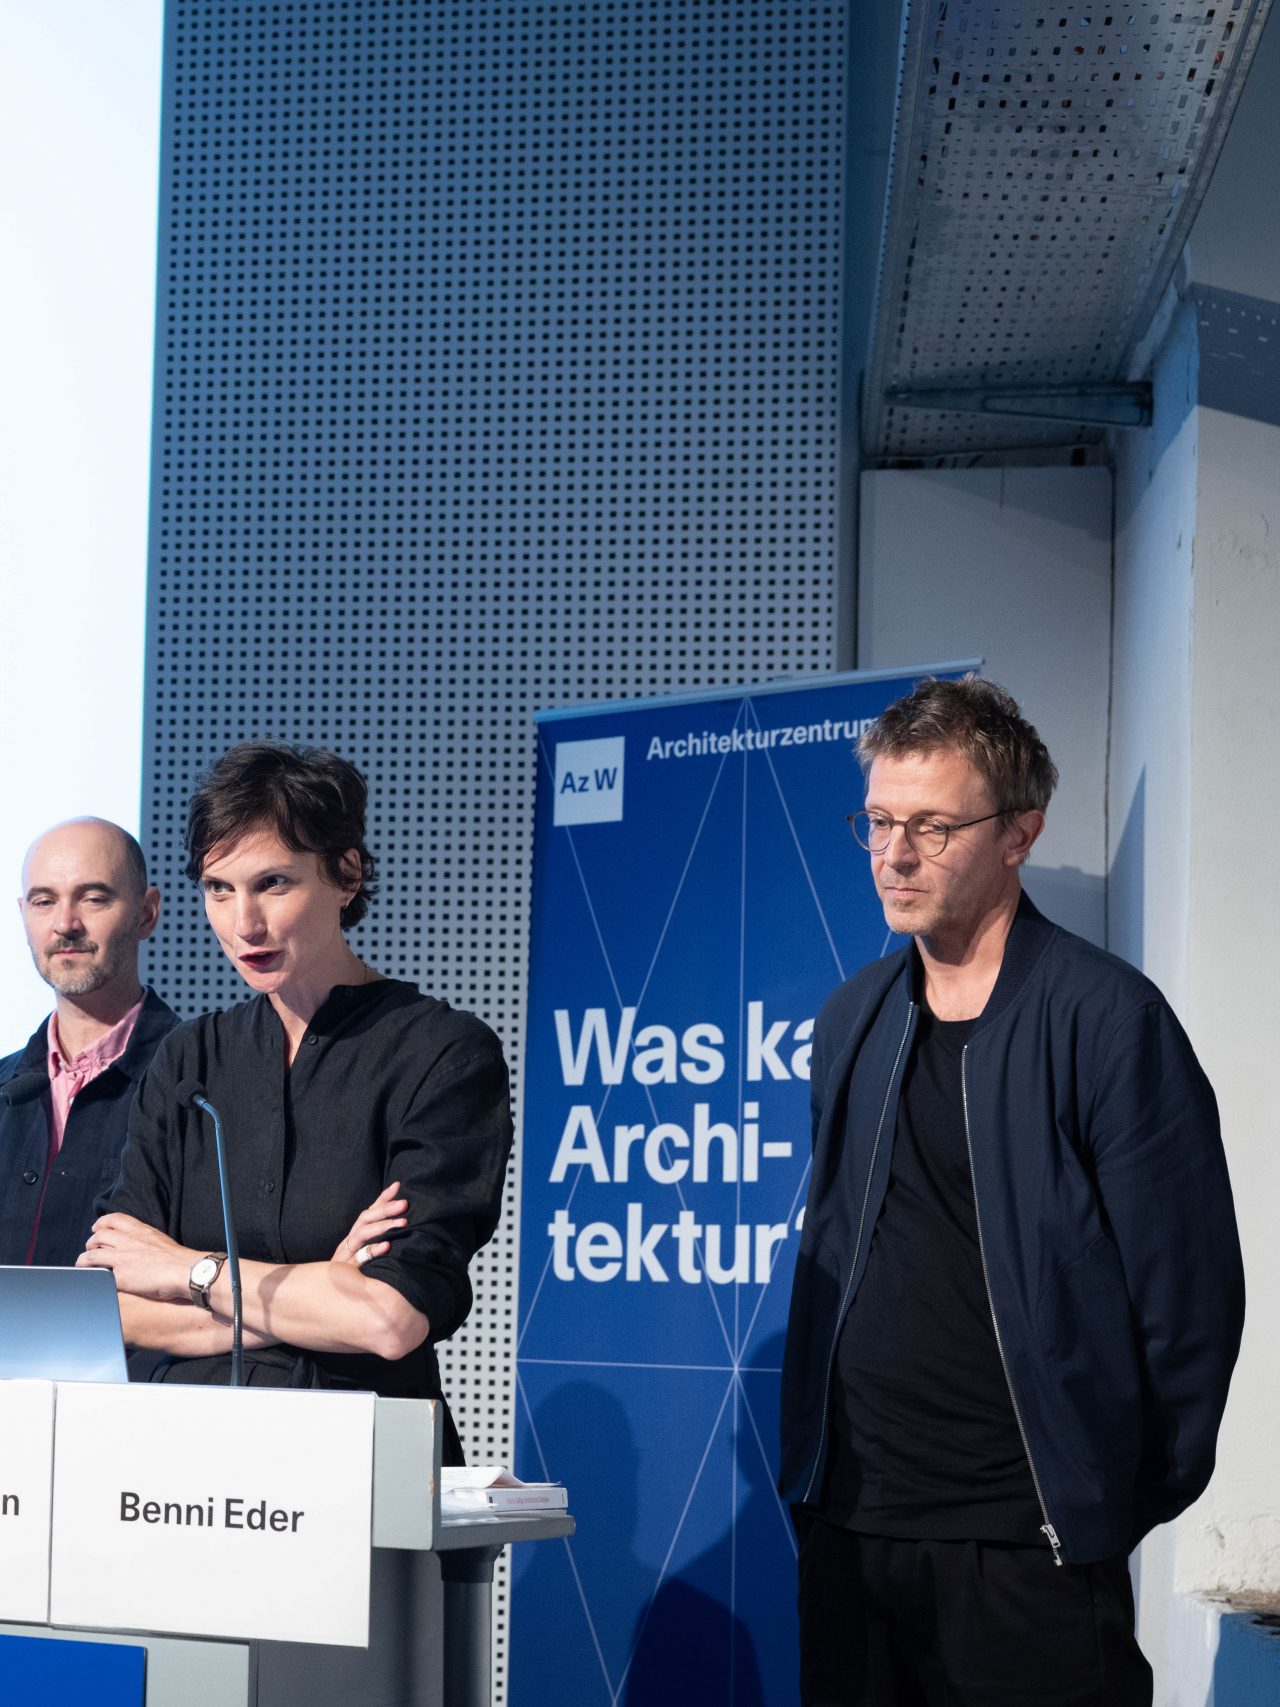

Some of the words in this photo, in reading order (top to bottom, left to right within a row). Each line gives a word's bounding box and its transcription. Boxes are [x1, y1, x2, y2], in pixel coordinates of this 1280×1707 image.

[555, 1007, 725, 1085] Was
[549, 1102, 792, 1184] Archi-
[120, 1492, 214, 1527] Benni
[224, 1498, 304, 1532] Eder
